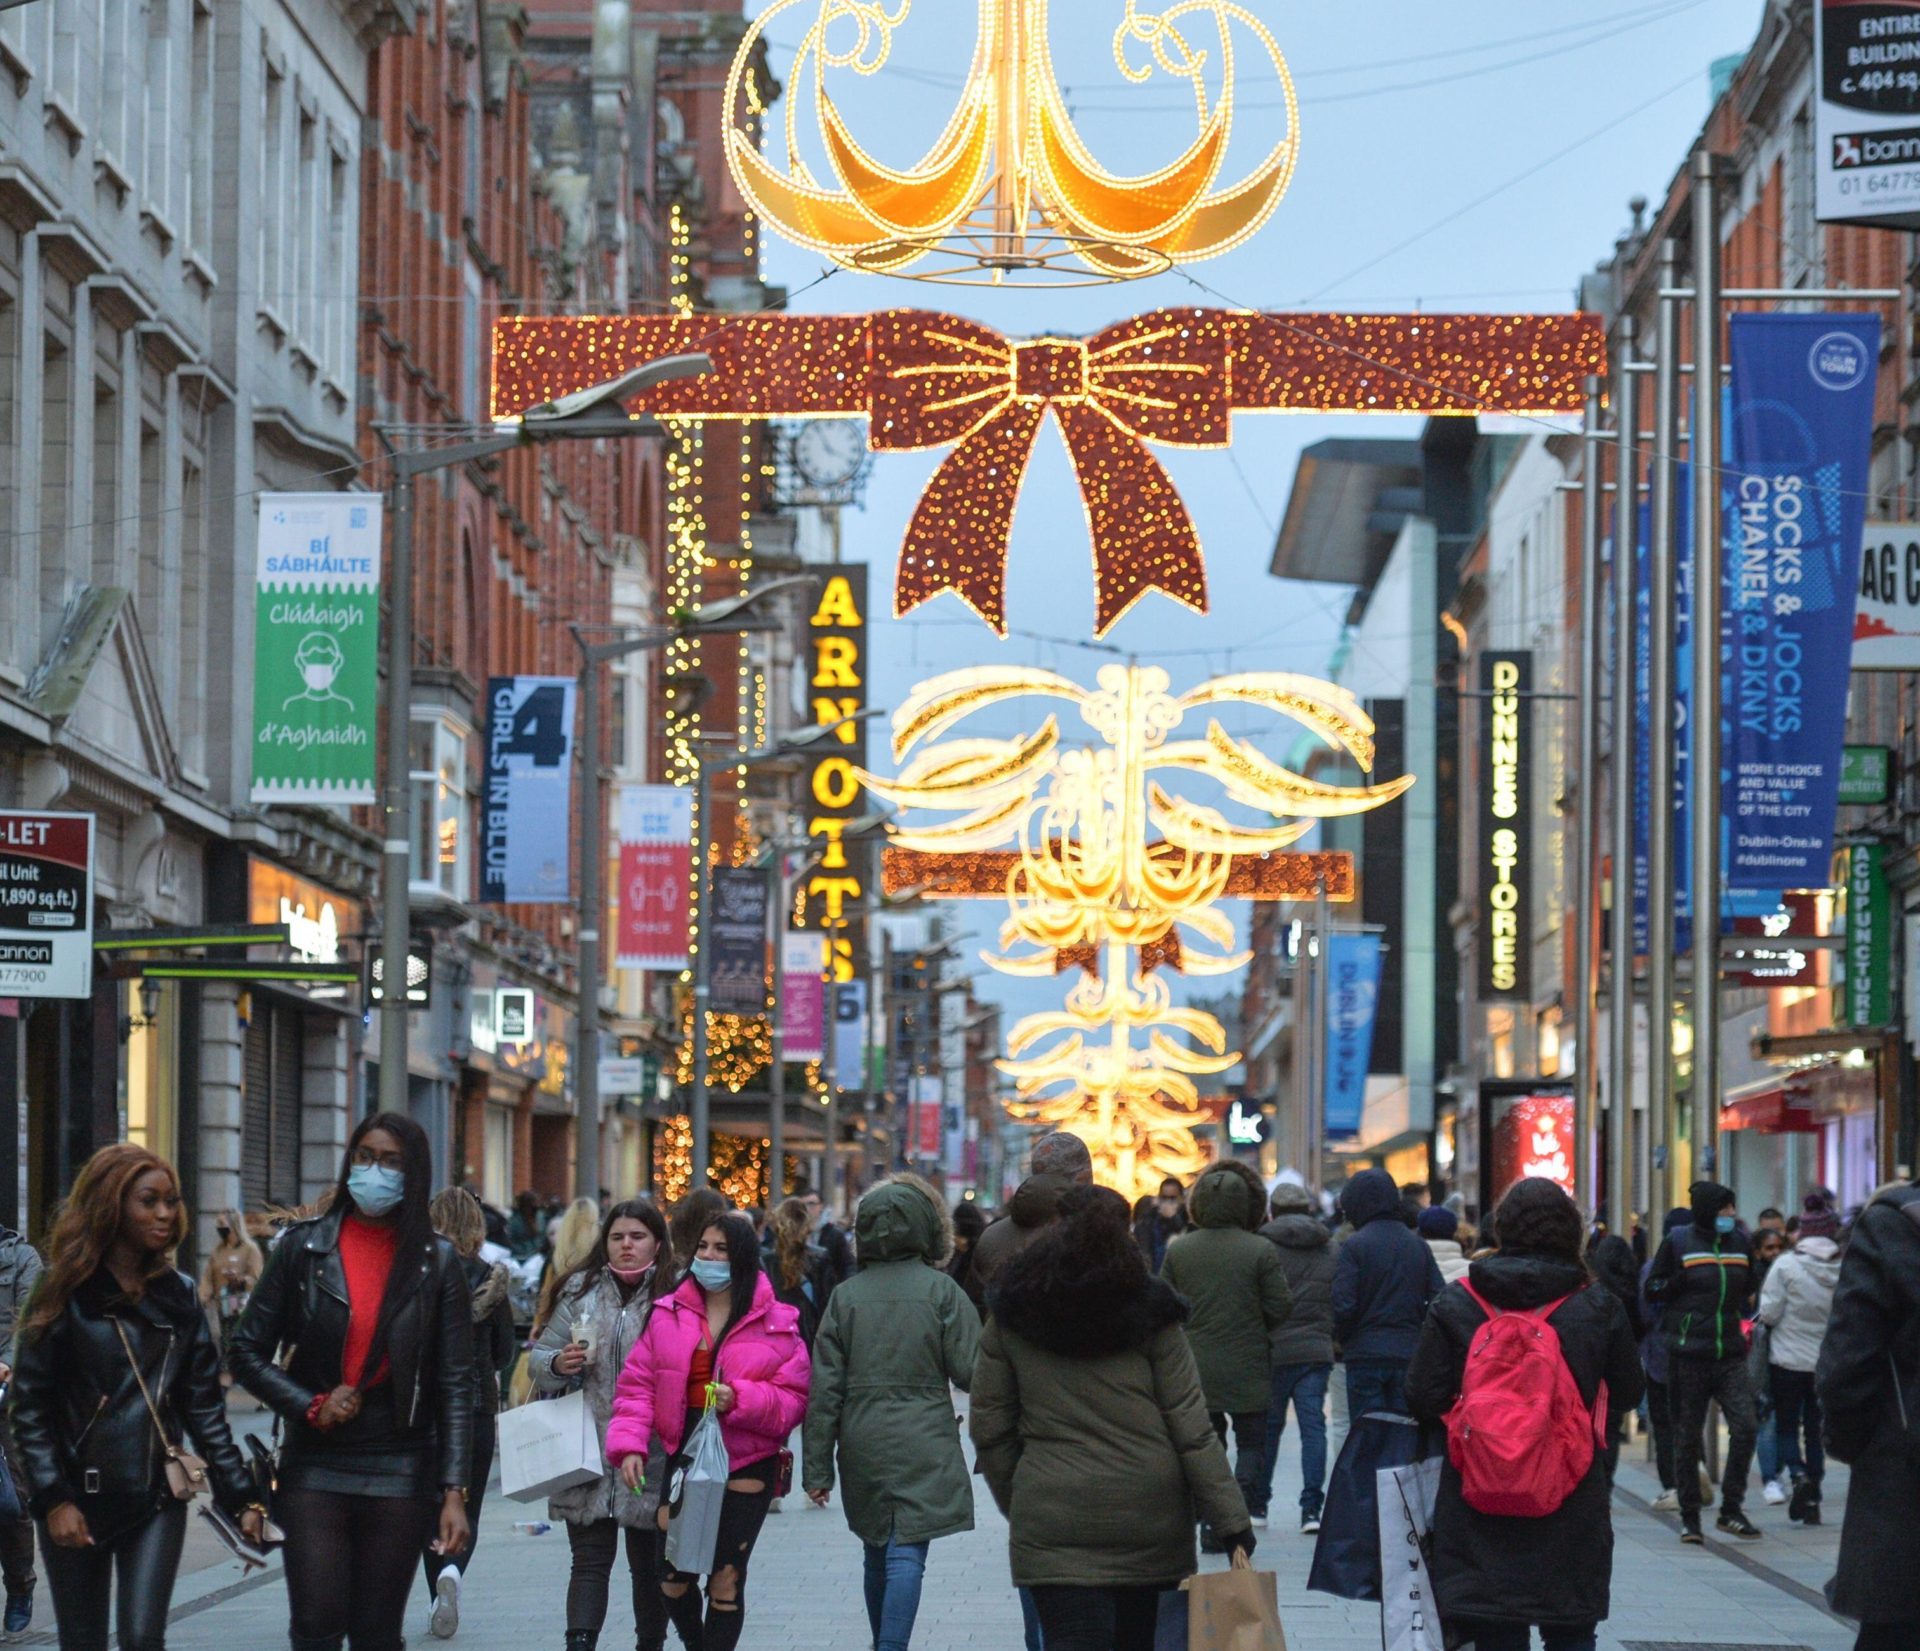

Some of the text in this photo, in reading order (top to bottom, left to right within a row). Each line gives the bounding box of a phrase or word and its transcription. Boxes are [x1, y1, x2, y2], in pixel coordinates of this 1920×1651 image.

[1860, 14, 1920, 38] ENTIRE
[1859, 70, 1894, 91] 404
[1840, 177, 1860, 195] 01
[310, 535, 330, 554] BÍ
[266, 554, 371, 573] SÁBHÁILTE
[1740, 475, 1769, 734] CHANEL & DKNY
[1769, 475, 1802, 740] SOCKS & JOCKS,
[269, 602, 364, 633] Clúdaigh
[506, 686, 567, 767] 4
[809, 575, 862, 983] ARNOTTS
[1738, 763, 1822, 776] MORE CHOICE
[487, 687, 515, 884] GIRLS IN BLUE
[1738, 777, 1807, 790] AND VALUE
[1738, 790, 1780, 802] AT THE
[1738, 804, 1812, 817] OF THE CITY
[1490, 660, 1519, 990] DUNNES STORES
[1738, 834, 1823, 849] Dublin-One.ie
[1736, 854, 1807, 867] #dublinone
[11, 863, 40, 882] Unit
[1854, 846, 1873, 1025] ACUPUNCTURE
